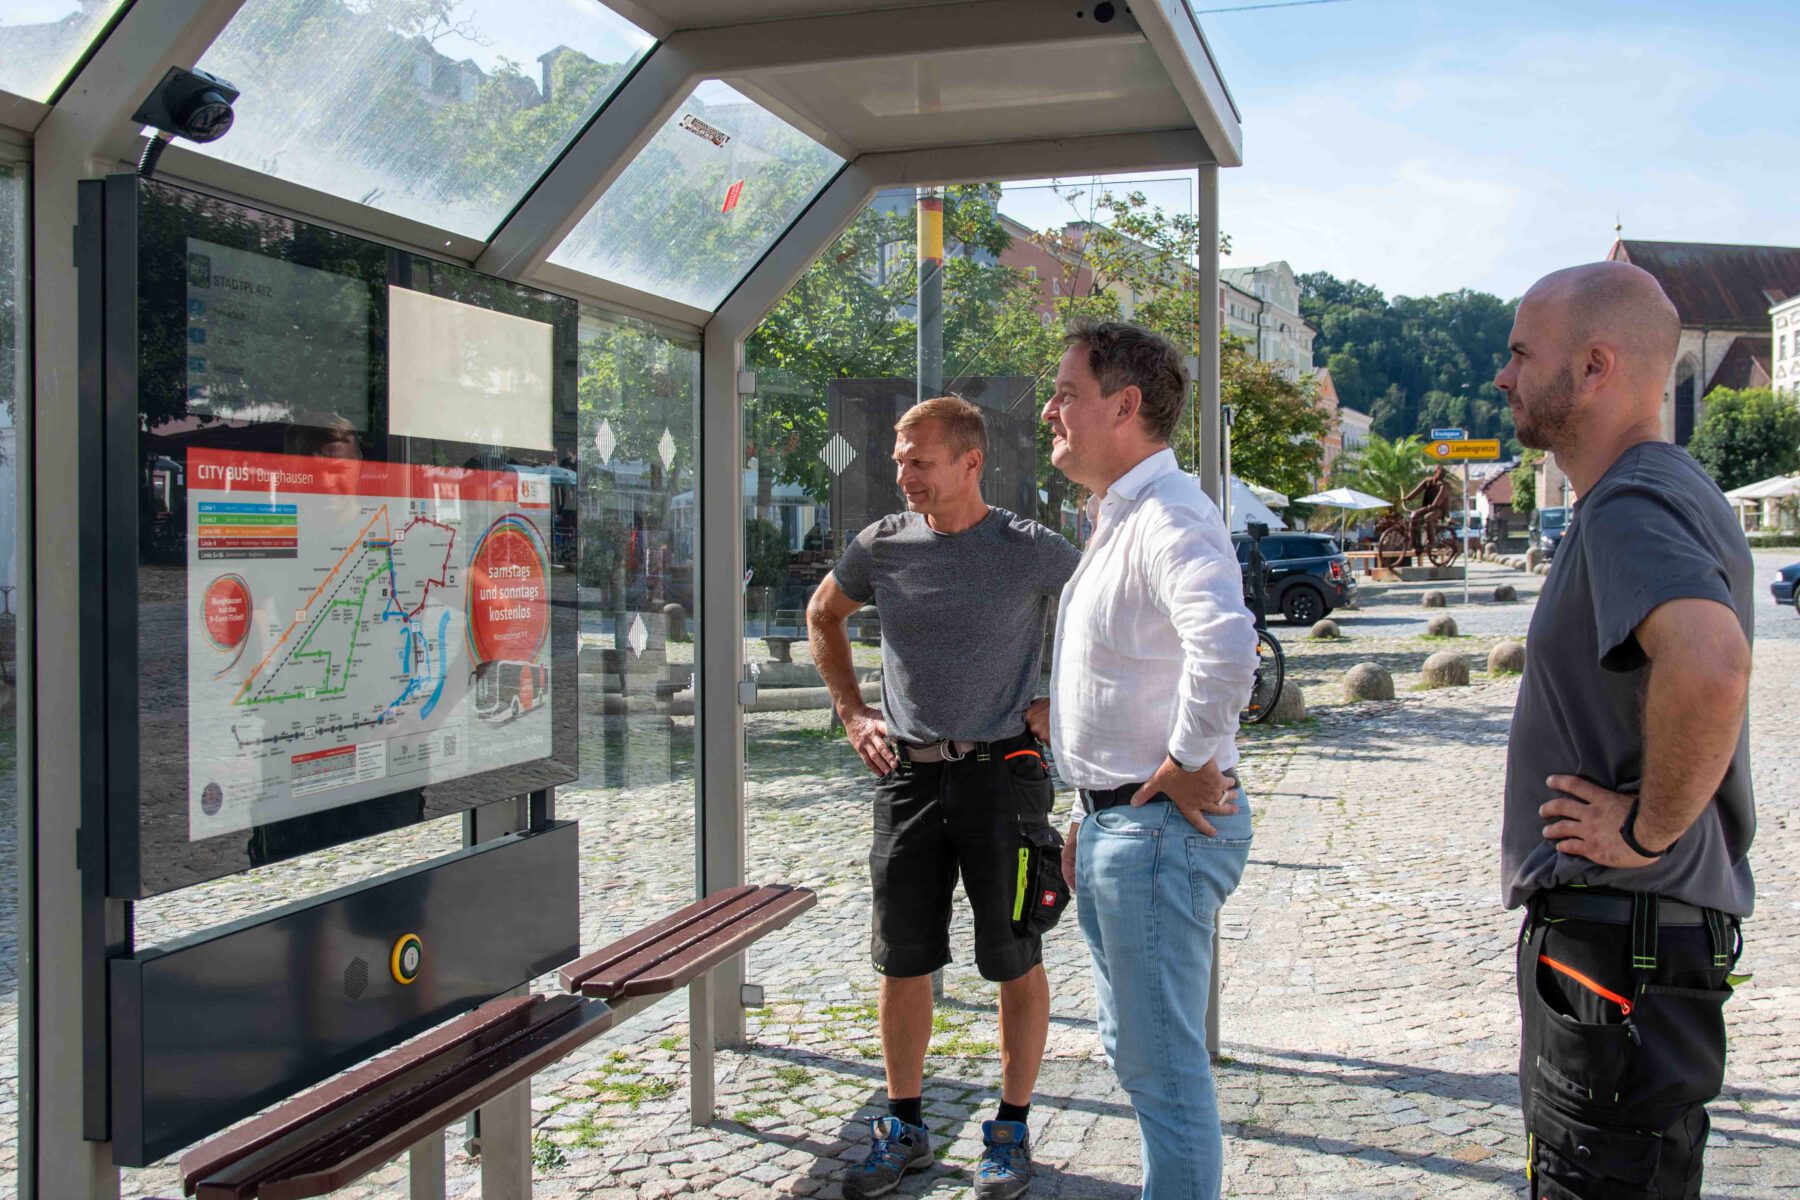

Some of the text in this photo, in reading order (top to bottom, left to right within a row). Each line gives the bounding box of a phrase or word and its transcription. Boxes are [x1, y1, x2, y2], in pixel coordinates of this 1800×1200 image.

[1452, 444, 1496, 454] Landesgrenze
[198, 464, 314, 486] CITY BUS Burghausen
[488, 565, 531, 581] samstags
[480, 585, 539, 602] und sonntags
[489, 604, 531, 622] kostenlos
